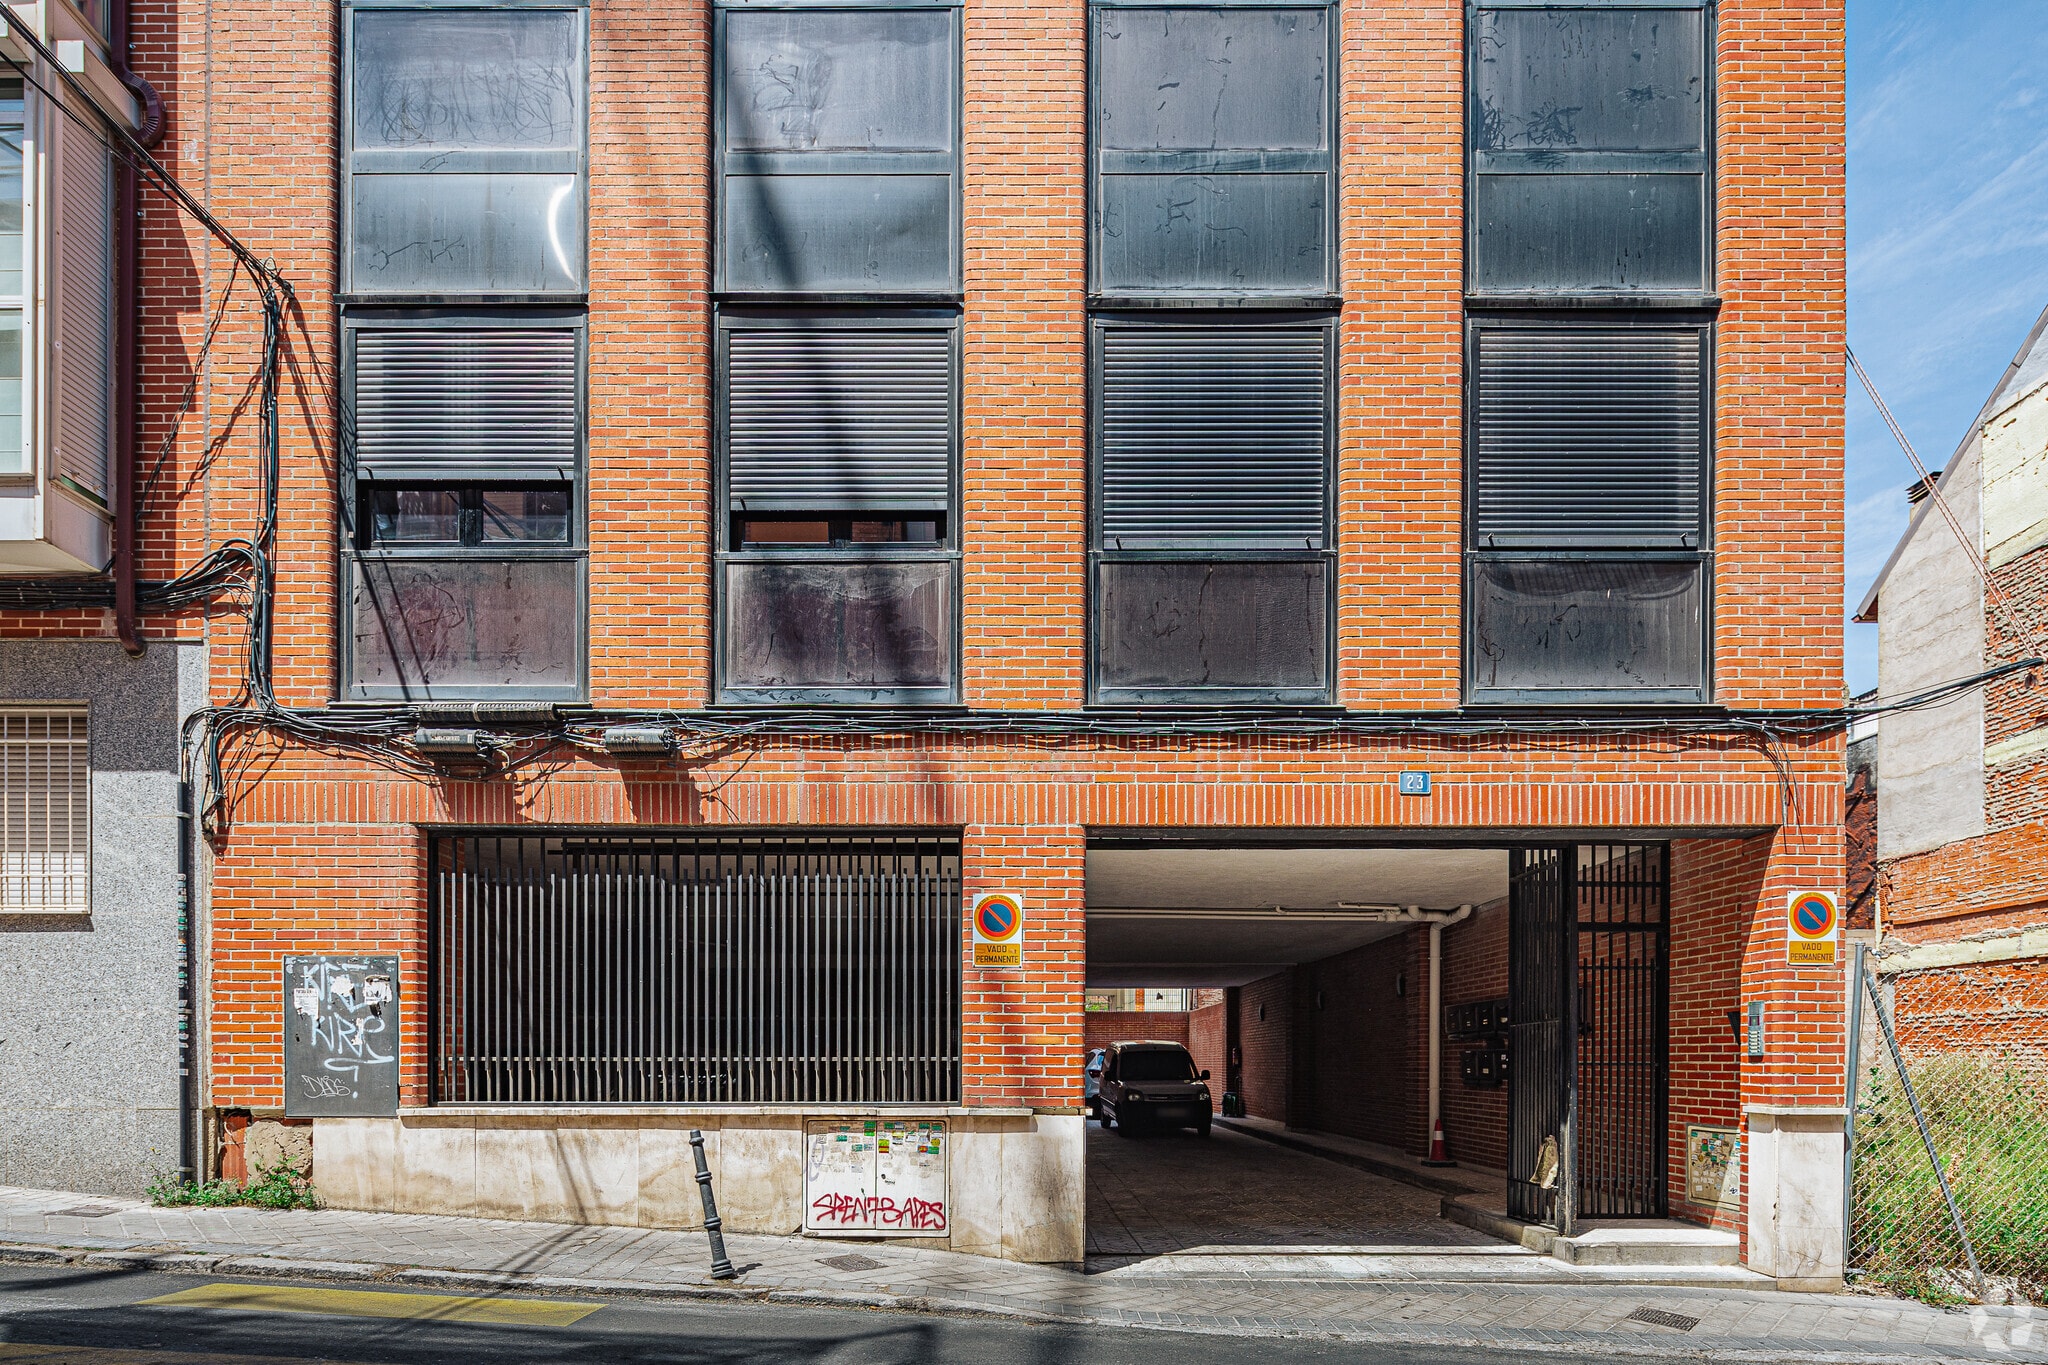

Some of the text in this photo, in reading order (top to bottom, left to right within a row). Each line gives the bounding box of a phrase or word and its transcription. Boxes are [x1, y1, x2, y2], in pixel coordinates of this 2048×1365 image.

[1407, 775, 1424, 789] 23
[986, 945, 1007, 953] VADO
[1801, 942, 1822, 951] VADO
[975, 955, 1019, 964] PERMANENTE
[1790, 952, 1834, 961] PERMANENTE
